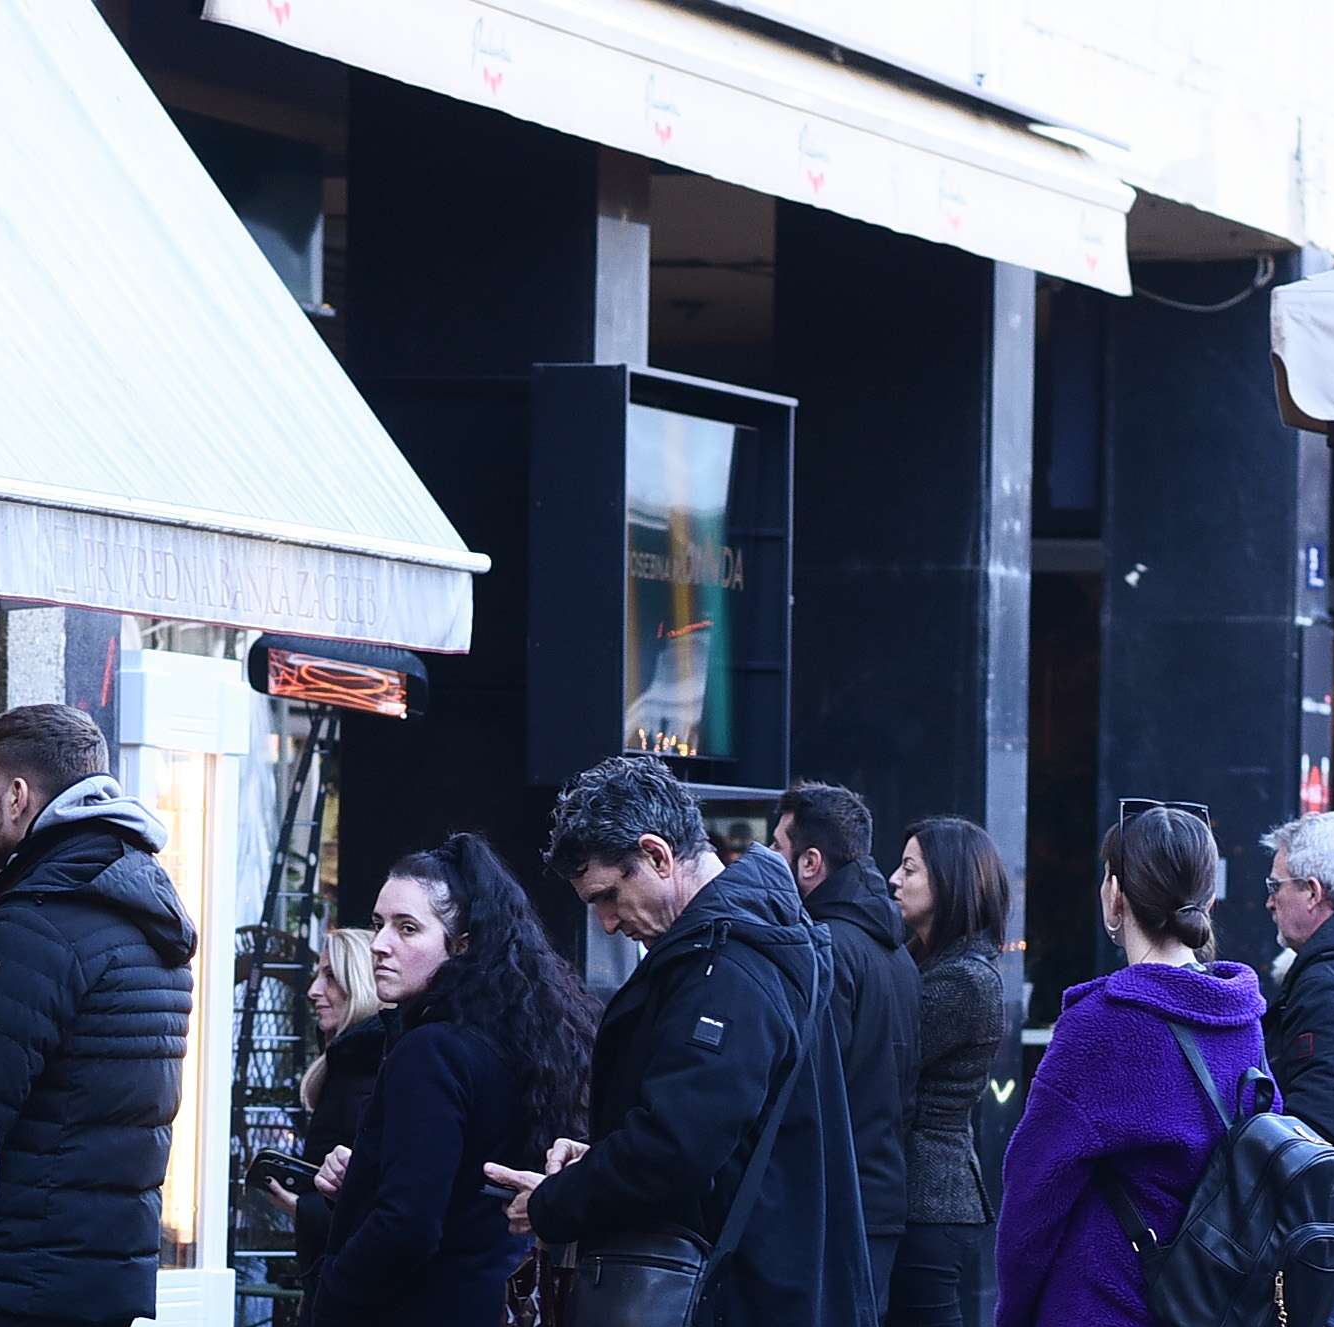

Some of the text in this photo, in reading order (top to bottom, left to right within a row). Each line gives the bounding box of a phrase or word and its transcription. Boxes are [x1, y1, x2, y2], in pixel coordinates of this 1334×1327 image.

[83, 537, 377, 626] PRIVREDNA BANKA ZAGREB
